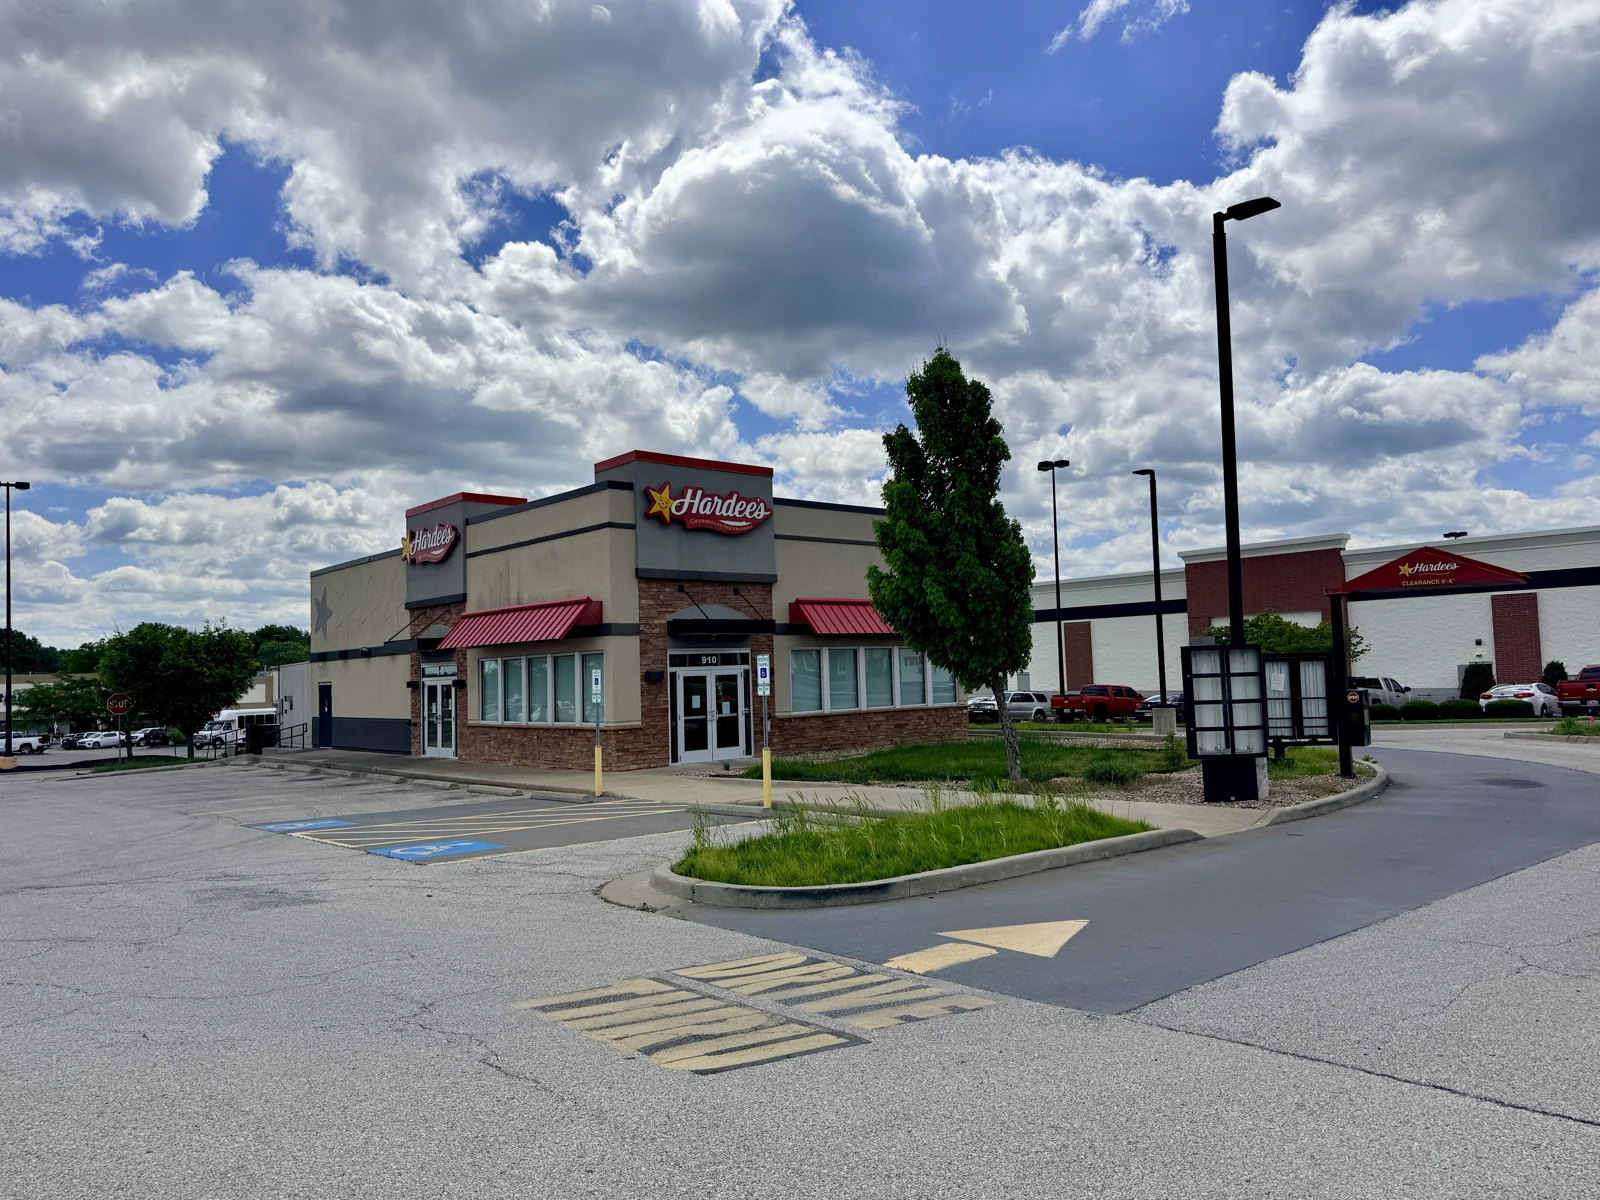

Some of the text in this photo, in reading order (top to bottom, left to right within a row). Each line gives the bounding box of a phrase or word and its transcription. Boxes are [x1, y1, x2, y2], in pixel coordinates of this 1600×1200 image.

[671, 489, 770, 519] Hardee's
[410, 524, 453, 556] Hardee's
[1409, 561, 1460, 574] Hardee's
[701, 656, 717, 664] 910
